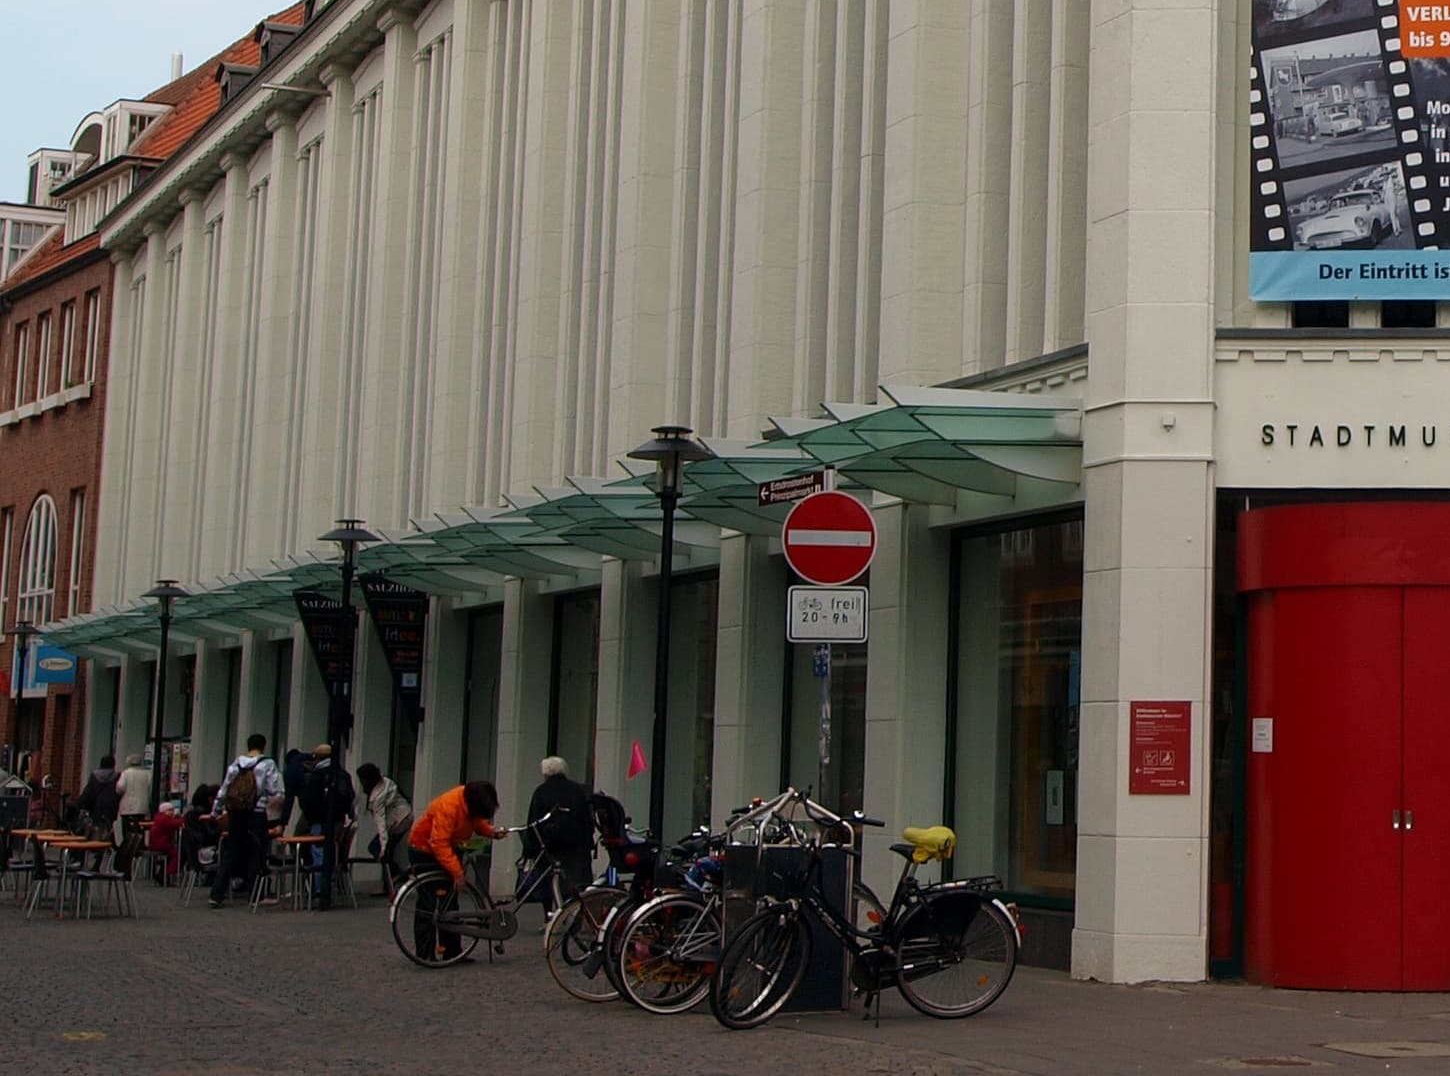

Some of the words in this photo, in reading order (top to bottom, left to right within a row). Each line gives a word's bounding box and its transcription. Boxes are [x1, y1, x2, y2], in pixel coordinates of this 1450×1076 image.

[1409, 31, 1435, 47] bis
[1431, 124, 1446, 139] in
[1435, 149, 1450, 163] in
[1319, 263, 1354, 280] Der
[1359, 263, 1428, 280] Eintritt
[367, 582, 416, 593] SALZHO
[831, 597, 855, 610] frei
